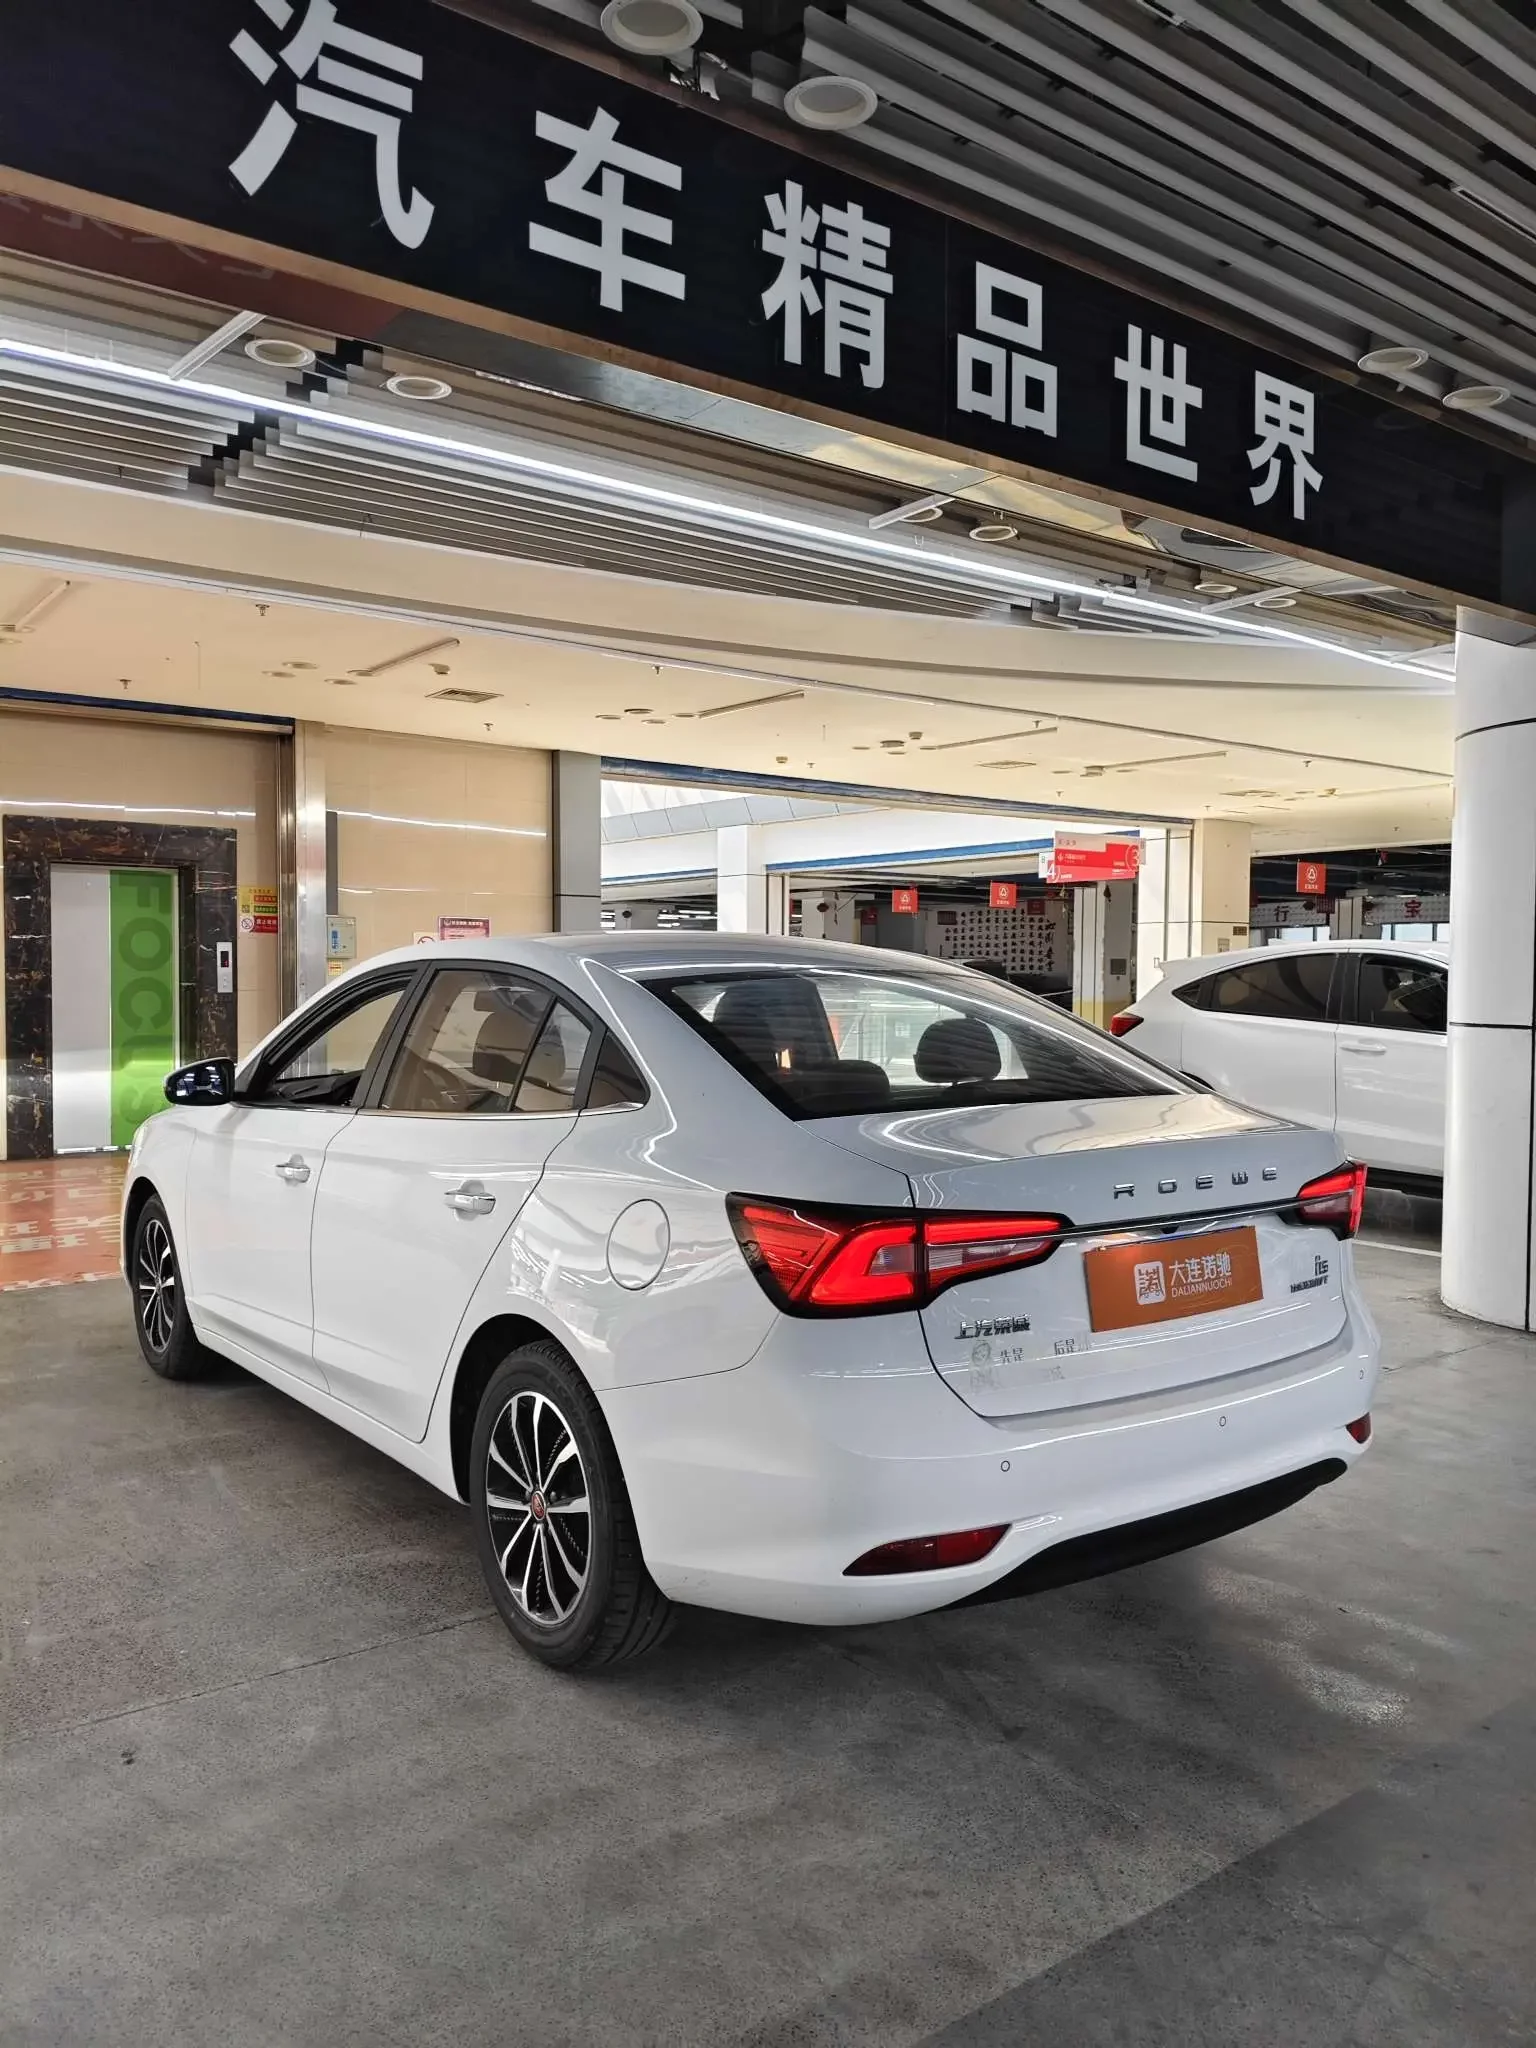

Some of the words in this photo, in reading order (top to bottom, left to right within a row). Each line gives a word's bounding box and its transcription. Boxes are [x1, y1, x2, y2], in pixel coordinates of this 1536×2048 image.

[228, 0, 1323, 521] 汽车精品世界
[1274, 904, 1290, 923] 行
[119, 874, 173, 1125] FOCUS
[1113, 1167, 1280, 1200] ROEWE
[1168, 1251, 1232, 1286] 大连诺驰
[1171, 1278, 1233, 1298] DALIANNUOCHI
